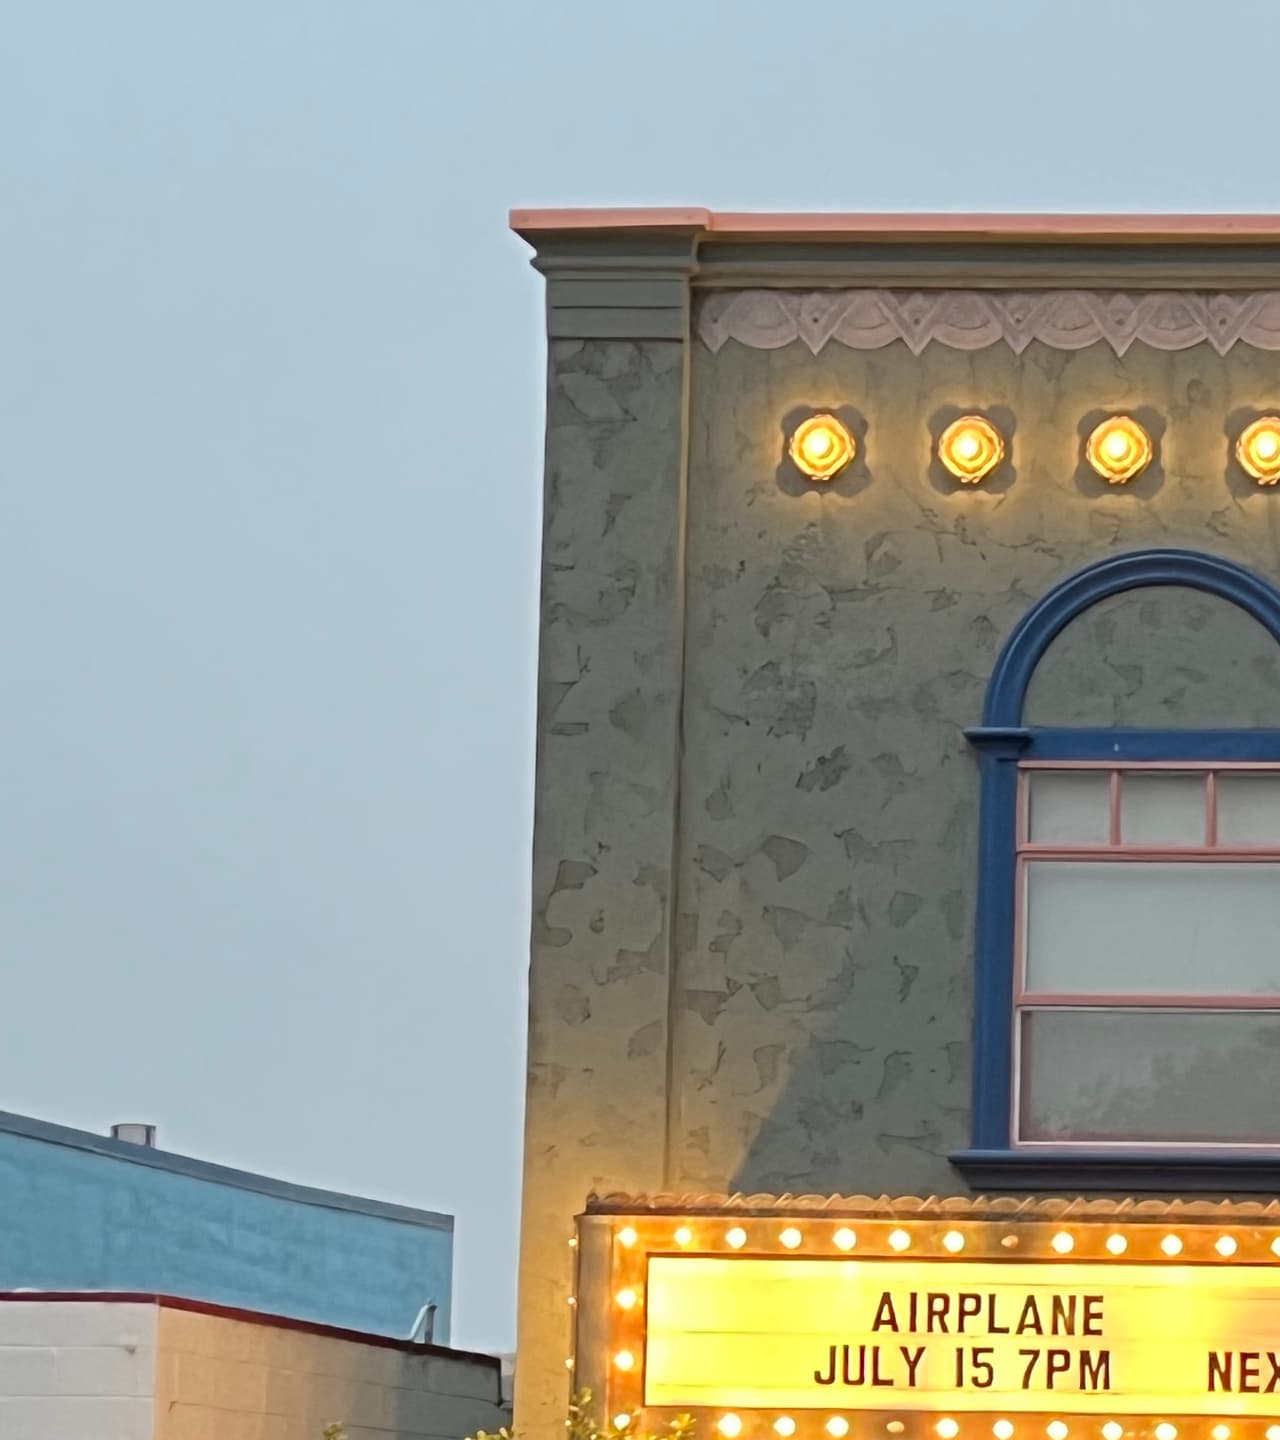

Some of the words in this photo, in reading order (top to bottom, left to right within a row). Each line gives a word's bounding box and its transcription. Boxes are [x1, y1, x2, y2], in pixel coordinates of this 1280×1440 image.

[872, 1292, 1104, 1337] AIRPLANE
[813, 1344, 926, 1388] JULY
[955, 1347, 995, 1389] 15
[1018, 1349, 1111, 1391] 7PM
